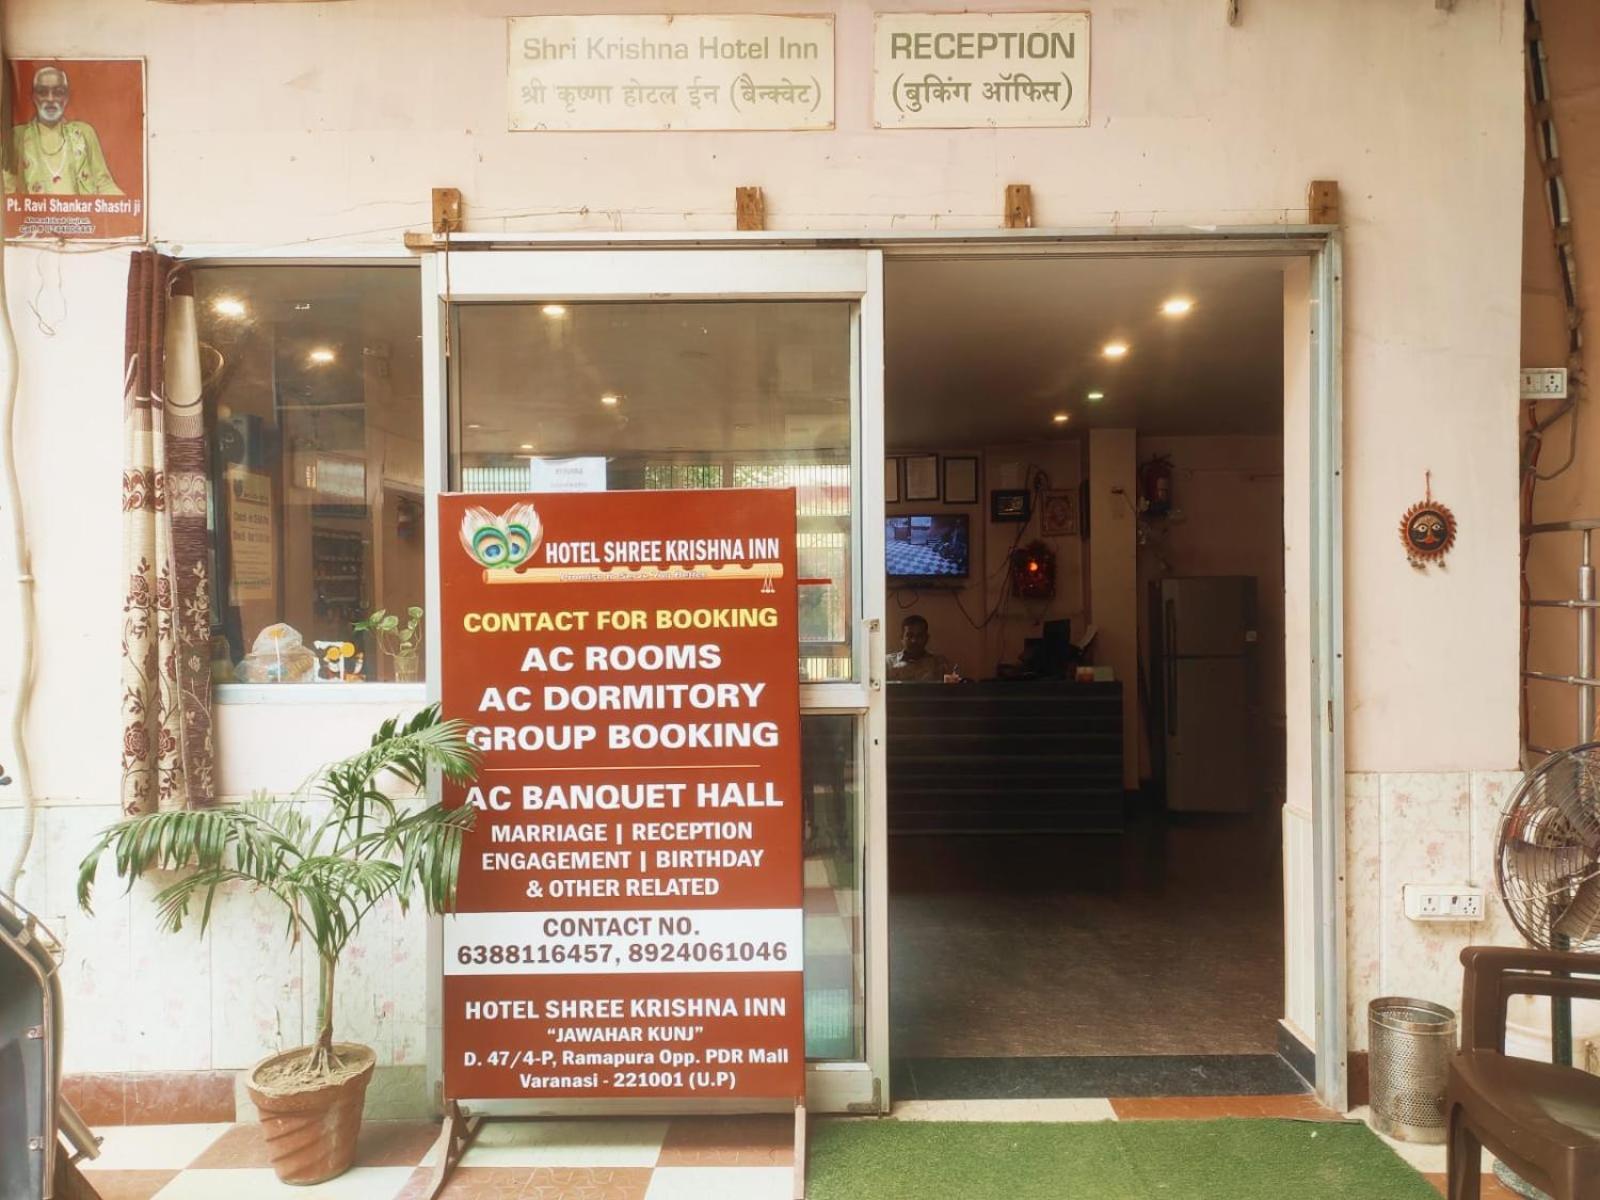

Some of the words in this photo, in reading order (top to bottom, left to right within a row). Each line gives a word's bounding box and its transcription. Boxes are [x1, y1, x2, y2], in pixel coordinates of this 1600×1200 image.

[523, 36, 577, 60] Shri
[587, 36, 689, 60] Krishna
[699, 36, 769, 60] Hotel
[779, 36, 819, 60] Inn
[891, 32, 1075, 60] RECEPTION
[521, 77, 547, 104] श्री
[556, 85, 614, 113] कृष्णा
[621, 77, 679, 106] होटल
[686, 76, 721, 109] ईन
[729, 73, 822, 113] (बैन्क्वेट)
[892, 73, 972, 112] (बुकिंग
[982, 73, 1073, 111] ऑफिस)
[6, 198, 21, 212] Pt.
[24, 198, 47, 212] Ravi
[49, 198, 92, 213] Shankar
[94, 198, 132, 213] Shastri
[133, 199, 141, 216] ji
[545, 542, 601, 563] HOTEL
[603, 541, 662, 563] SHREE
[665, 539, 745, 562] KRISHNA
[748, 538, 780, 560] INN
[463, 611, 590, 633] CONTACT
[596, 609, 648, 631] FOR
[656, 607, 778, 629] BOOKING
[520, 646, 574, 672] AC
[585, 643, 722, 671] ROOMS
[478, 685, 532, 712] AC
[543, 682, 766, 711] DORMITORY
[466, 725, 597, 751] GROUP
[608, 721, 779, 750] BOOKING
[464, 785, 512, 811] AC
[522, 784, 687, 811] BANQUET
[696, 781, 784, 808] HALL
[491, 823, 608, 843] MARRIAGE
[631, 821, 753, 841] RECEPTION
[482, 850, 633, 871] ENGAGEMENT
[656, 848, 765, 869] BIRTHDAY
[525, 879, 544, 898] &
[548, 878, 621, 898] OTHER
[625, 877, 720, 897] RELATED
[542, 917, 652, 938] CONTACT
[658, 916, 700, 936] NO.
[457, 943, 621, 966] 6388116457,
[628, 941, 788, 963] 8924061046
[465, 1000, 540, 1020] HOTEL
[545, 999, 625, 1019] SHREE
[629, 997, 739, 1018] KRISHNA
[743, 997, 786, 1017] INN
[547, 1026, 644, 1043] “JAWAHAR
[647, 1025, 704, 1042] KUNJ”
[463, 1051, 483, 1067] D.
[486, 1050, 557, 1069] 47/4-P,
[562, 1049, 655, 1068] Ramapura
[658, 1048, 701, 1068] Opp.
[705, 1048, 744, 1064] PDR
[748, 1047, 789, 1064] Mall
[519, 1072, 599, 1089] Varanasi
[613, 1071, 684, 1088] 221001
[688, 1071, 736, 1091] (U.P)
